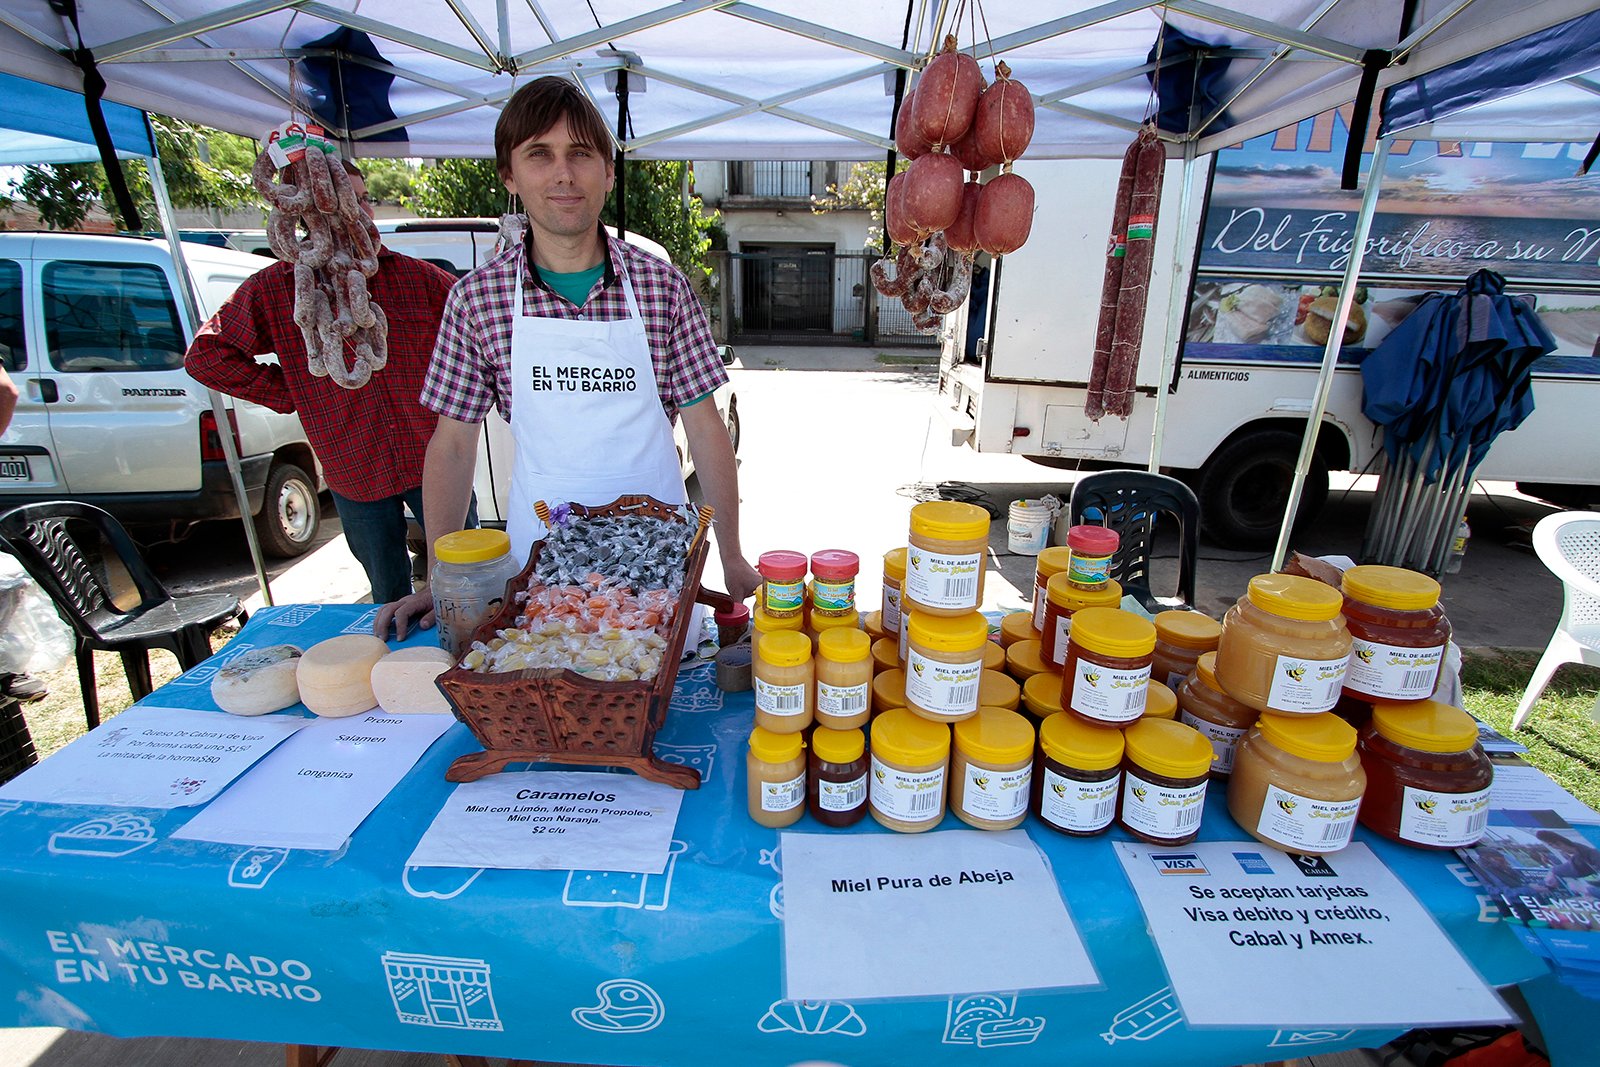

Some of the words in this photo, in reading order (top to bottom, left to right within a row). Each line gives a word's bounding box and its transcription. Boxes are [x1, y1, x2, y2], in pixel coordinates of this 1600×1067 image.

[1211, 207, 1293, 254] Del
[1471, 239, 1502, 259] a
[1505, 239, 1554, 260] su
[533, 366, 551, 378] EL
[557, 367, 635, 380] MERCADO
[1188, 370, 1250, 382] ALIMENTICIOS
[533, 380, 552, 391] EN
[557, 380, 576, 391] TU
[582, 381, 637, 392] BARRIO
[121, 388, 187, 397] PARTNER
[364, 716, 403, 726] Promo
[1210, 728, 1225, 736] MIEL
[336, 734, 387, 745] Salamen
[180, 742, 204, 750] cada
[111, 751, 141, 759] mitad
[141, 752, 155, 760] de
[298, 768, 353, 780] Longaniza
[516, 789, 616, 803] Caramelos
[465, 805, 488, 813] Miel
[513, 804, 550, 814] Limón,
[553, 805, 576, 814] Miel
[601, 808, 653, 818] Propoleo,
[507, 814, 531, 823] Miel
[557, 815, 601, 825] Naranja.
[532, 826, 546, 835] $2
[549, 826, 566, 834] c/u
[1163, 860, 1196, 869] VISA
[831, 878, 871, 893] Miel
[877, 877, 923, 891] Pura
[929, 874, 952, 887] de
[959, 869, 1014, 885] Abeja
[1189, 885, 1215, 899] Se
[1220, 885, 1294, 901] aceptan
[1297, 884, 1368, 901] tarjetas
[1519, 896, 1548, 908] EL
[1184, 907, 1230, 922] Visa
[1233, 907, 1293, 922] debito
[1296, 909, 1310, 924] y
[1315, 905, 1391, 922] crédito,
[1530, 909, 1560, 922] EN
[1560, 912, 1590, 924] TU
[1229, 930, 1287, 947] Cabal
[1290, 933, 1303, 949] y
[1309, 929, 1373, 945] Amex.
[46, 930, 100, 955] EL
[106, 937, 312, 981] MERCADO
[56, 959, 110, 983] EN
[118, 962, 169, 986] TU
[178, 970, 322, 1003] BARRIO
